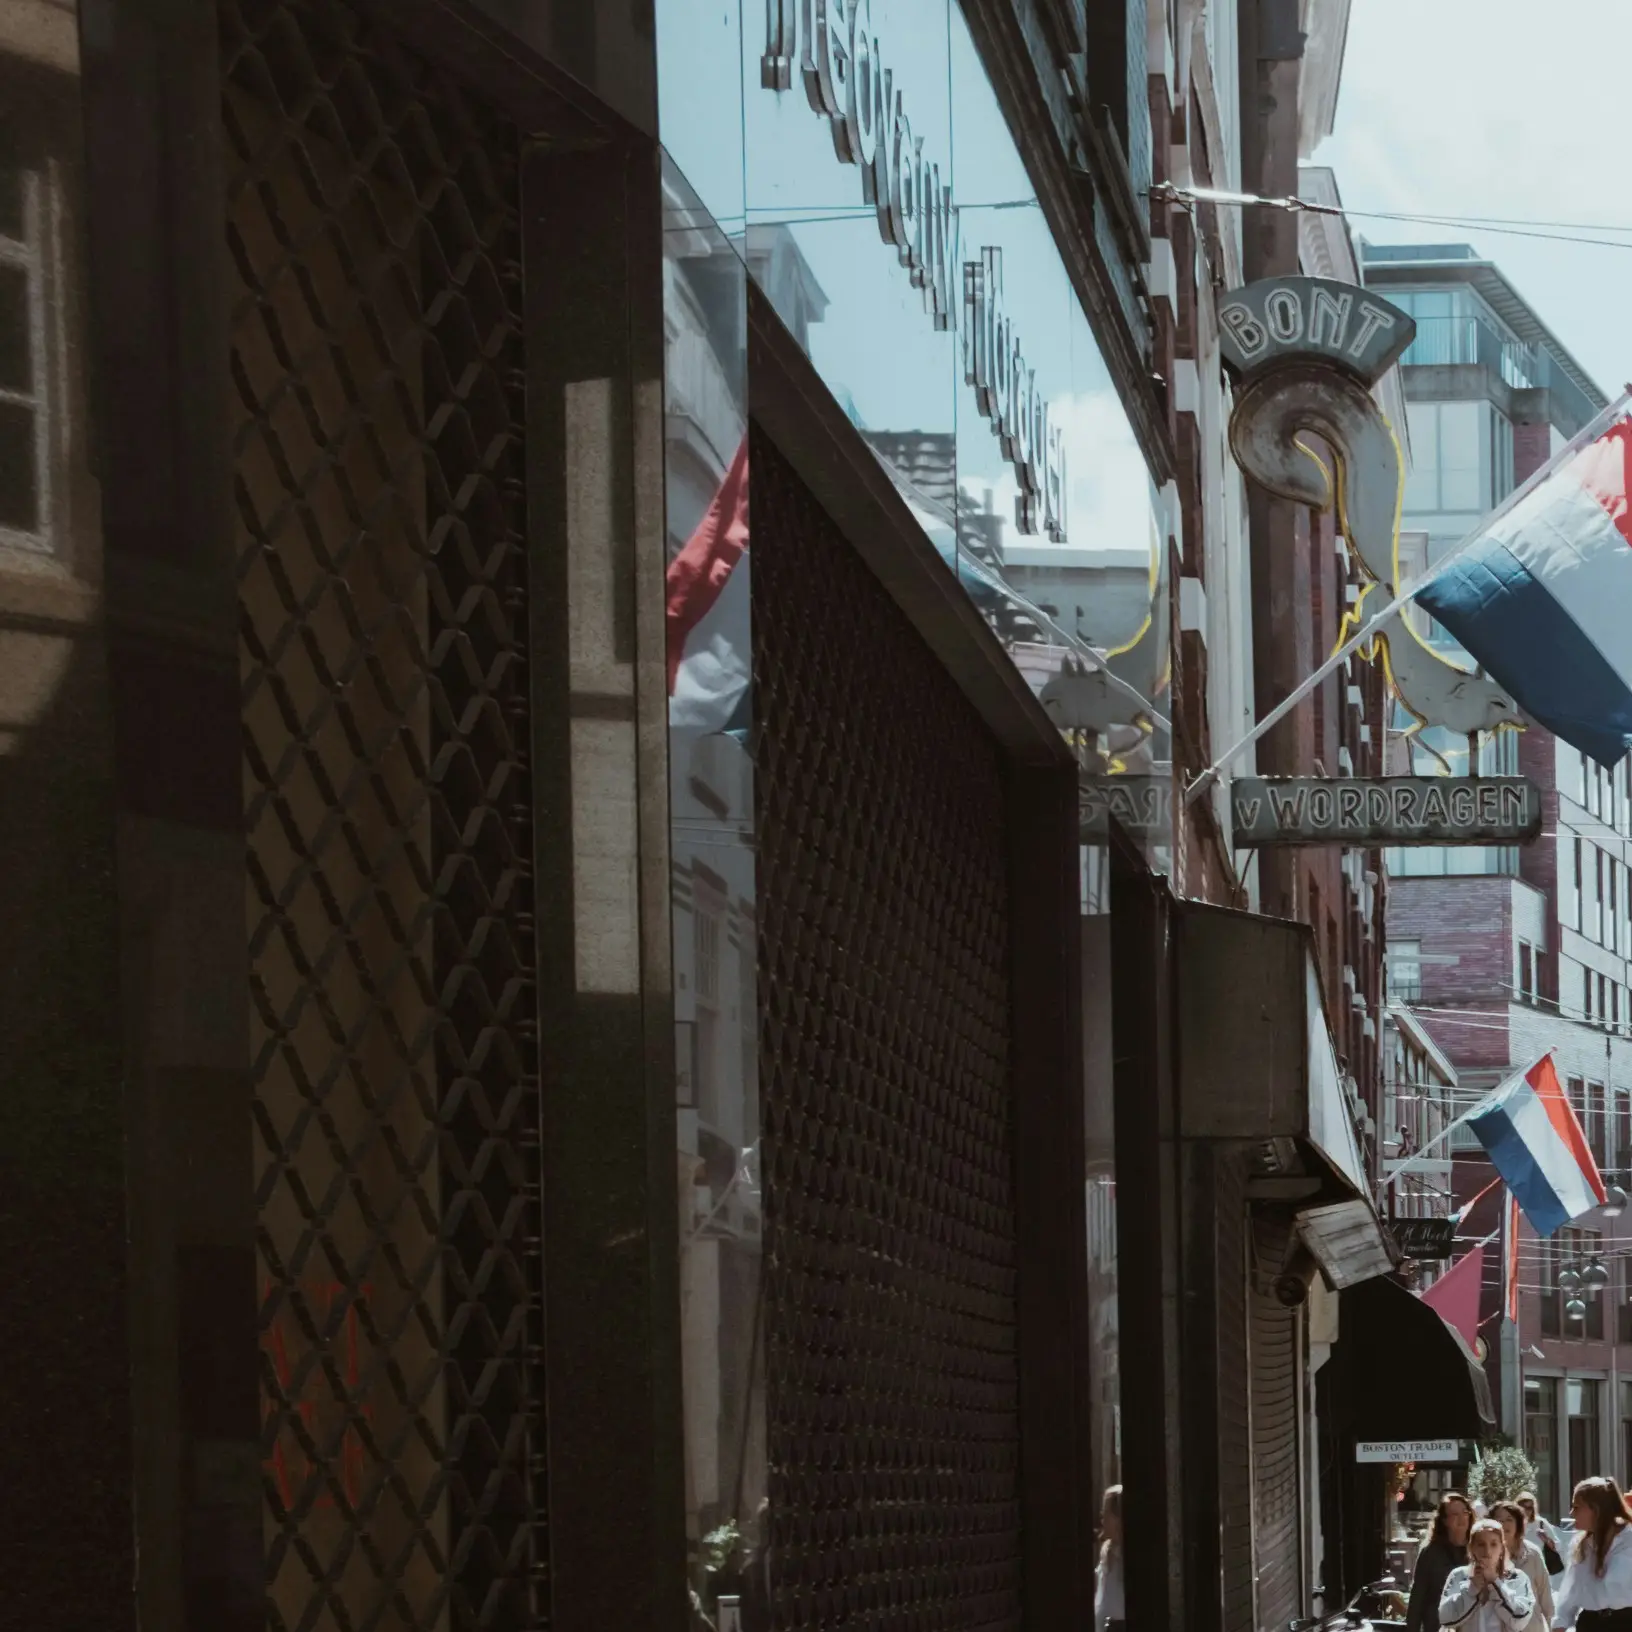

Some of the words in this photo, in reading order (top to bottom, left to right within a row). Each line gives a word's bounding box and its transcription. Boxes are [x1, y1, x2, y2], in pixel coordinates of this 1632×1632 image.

[1220, 290, 1396, 360] BONT
[1267, 784, 1529, 831] WORDRAGEN
[1362, 1443, 1407, 1453] BOSTON
[1409, 1442, 1453, 1451] TRADER
